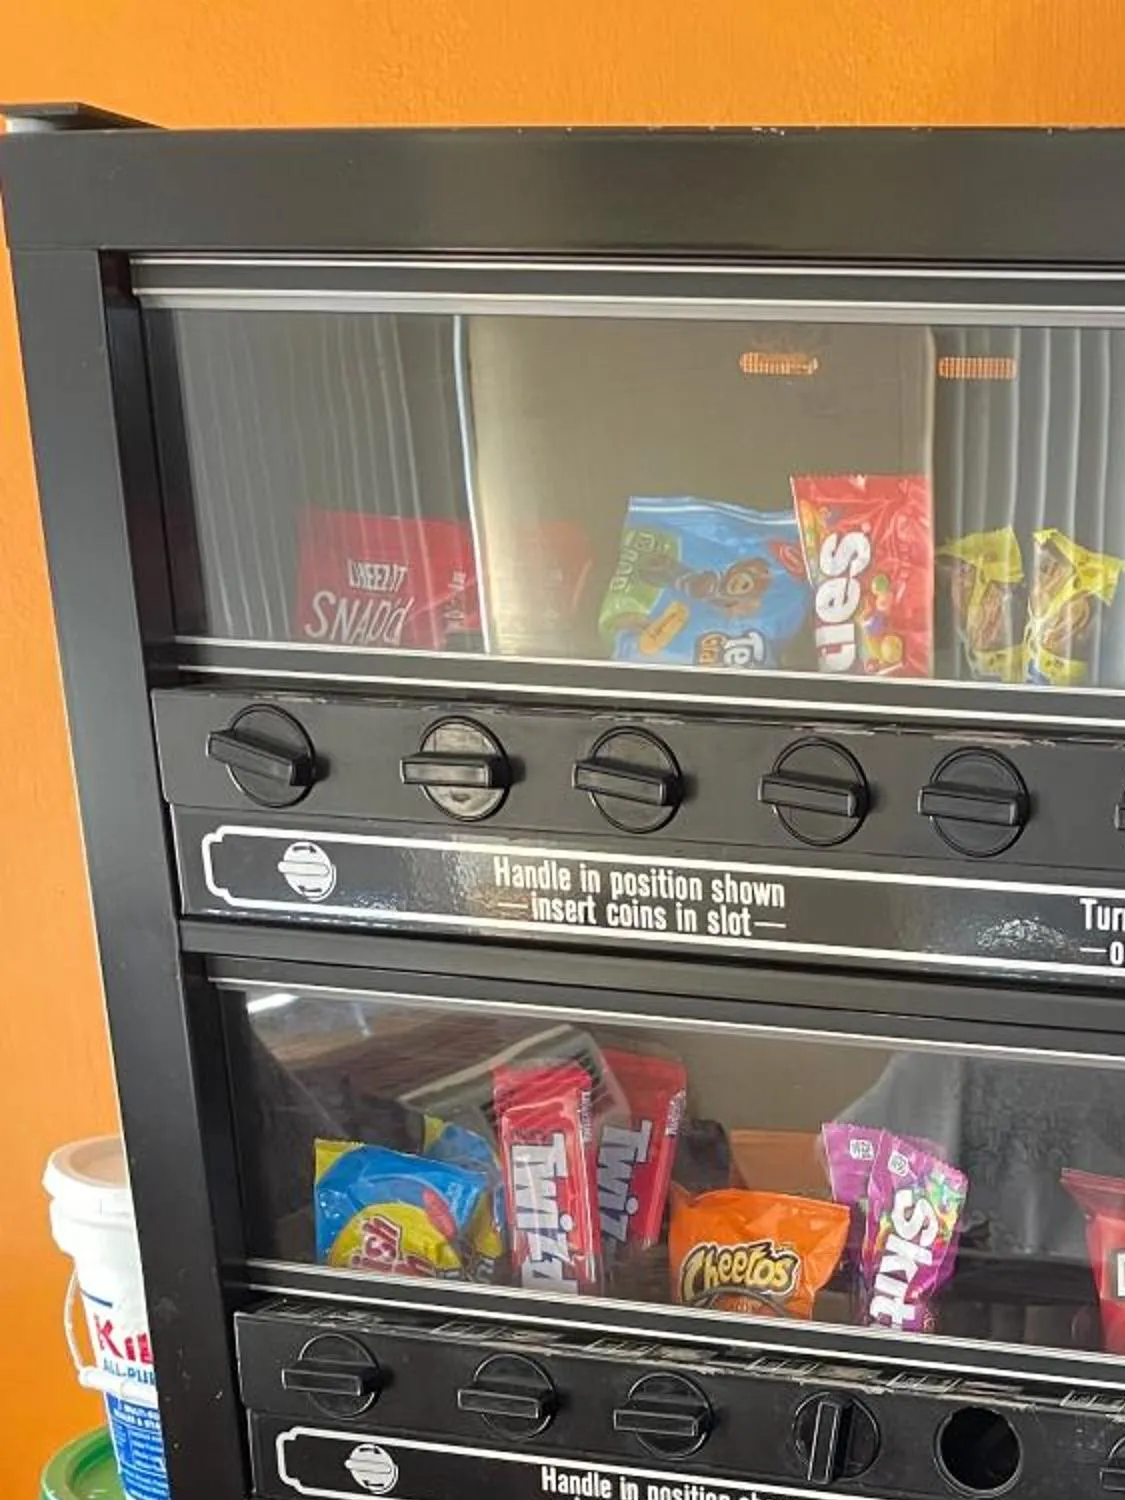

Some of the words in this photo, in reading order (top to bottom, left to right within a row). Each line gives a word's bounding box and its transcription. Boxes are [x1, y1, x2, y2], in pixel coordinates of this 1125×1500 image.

[494, 856, 571, 891] Handle
[580, 863, 600, 893] in
[610, 868, 702, 901] position
[711, 873, 785, 908] shown
[606, 900, 667, 930] coins
[676, 903, 697, 933] in
[682, 1241, 799, 1302] Cheetos
[541, 1466, 612, 1499] Handle
